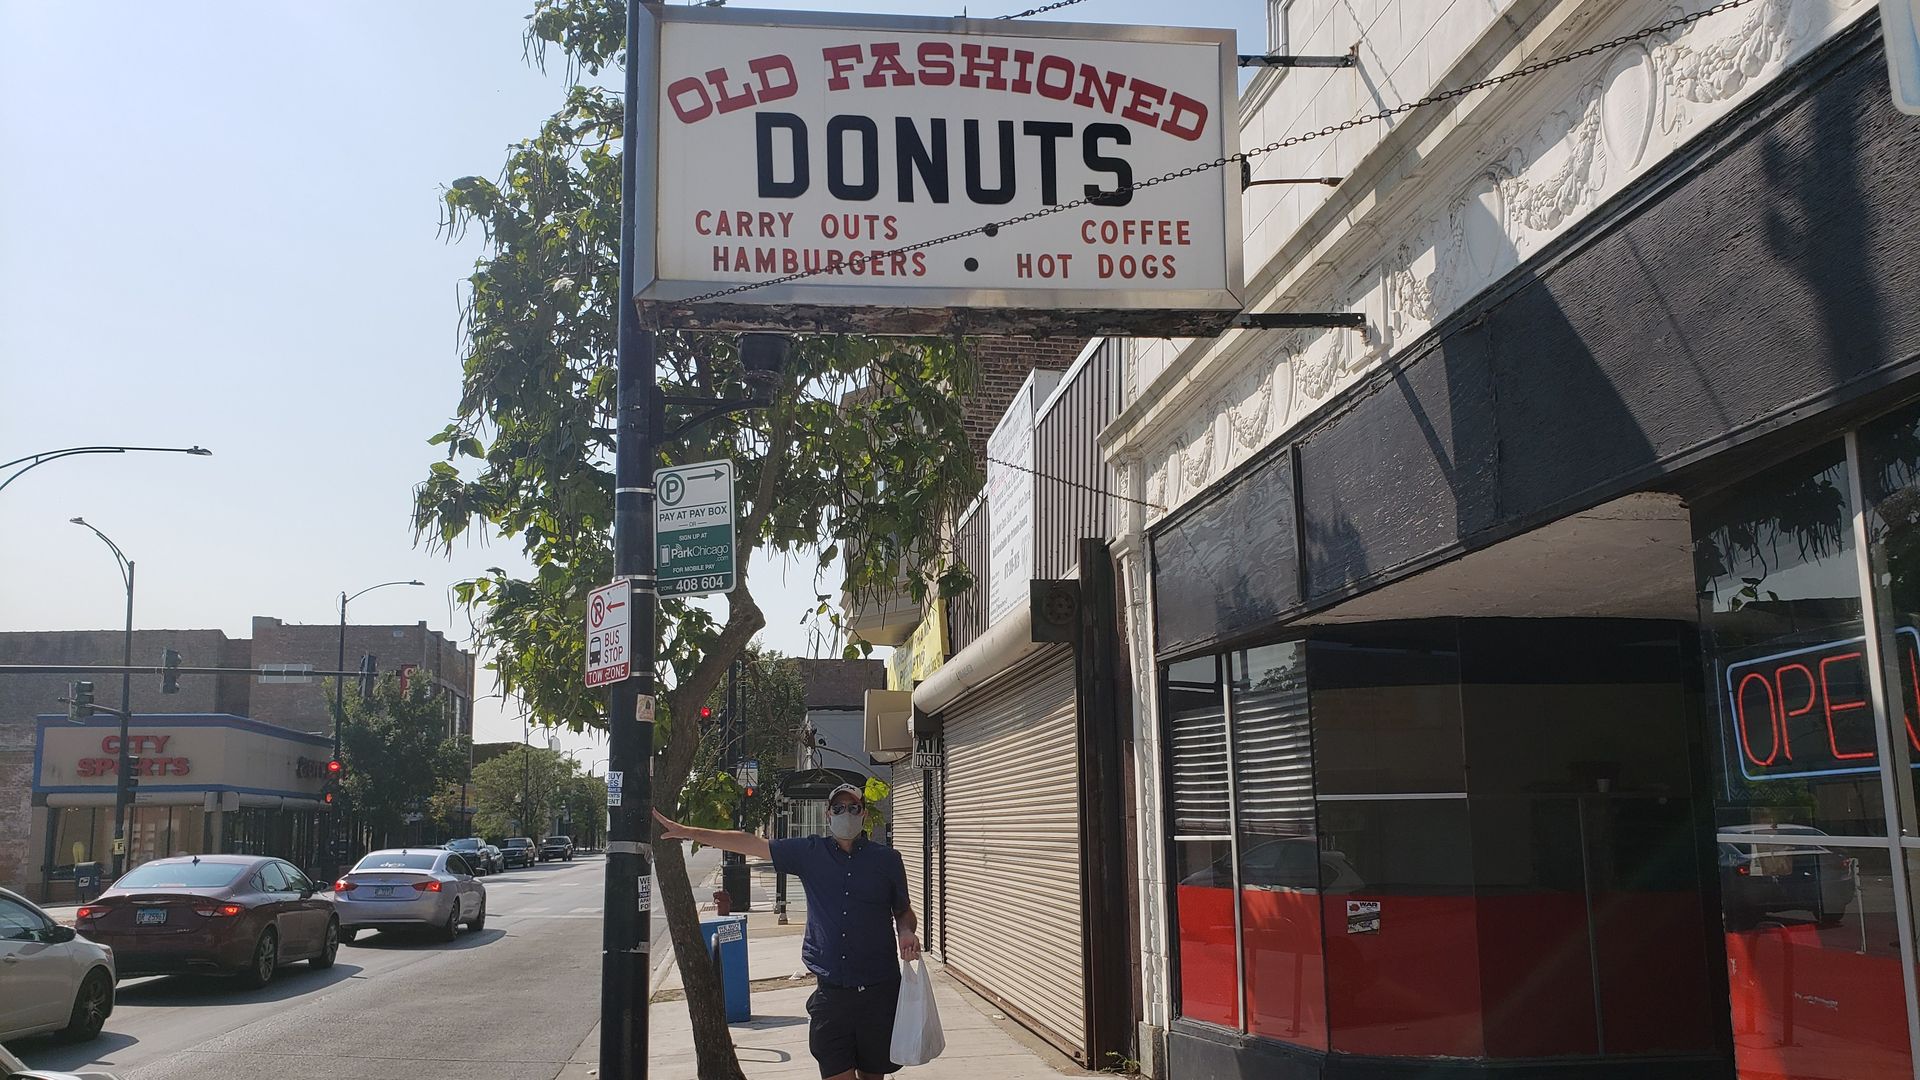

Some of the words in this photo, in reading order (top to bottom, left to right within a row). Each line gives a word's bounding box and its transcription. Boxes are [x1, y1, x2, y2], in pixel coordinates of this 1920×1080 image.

[667, 54, 798, 124] OLD
[823, 42, 1208, 141] FASHIONED
[755, 111, 1133, 206] DONUTS
[696, 210, 794, 238] CARRY
[821, 214, 899, 240] OUTS
[1081, 220, 1191, 245] COFFEE
[713, 245, 927, 277] HAMBURGERS
[1017, 253, 1071, 279] HOT
[1098, 254, 1176, 279] DOGS
[660, 512, 675, 521] PAY
[677, 511, 687, 520] AT
[690, 509, 705, 518] PAY
[708, 506, 727, 516] BOX
[676, 578, 698, 592] 408
[701, 576, 724, 589] 604
[605, 630, 619, 647] BUS
[604, 646, 623, 664] STOP
[588, 670, 603, 684] TOW
[605, 664, 625, 680] ZONE
